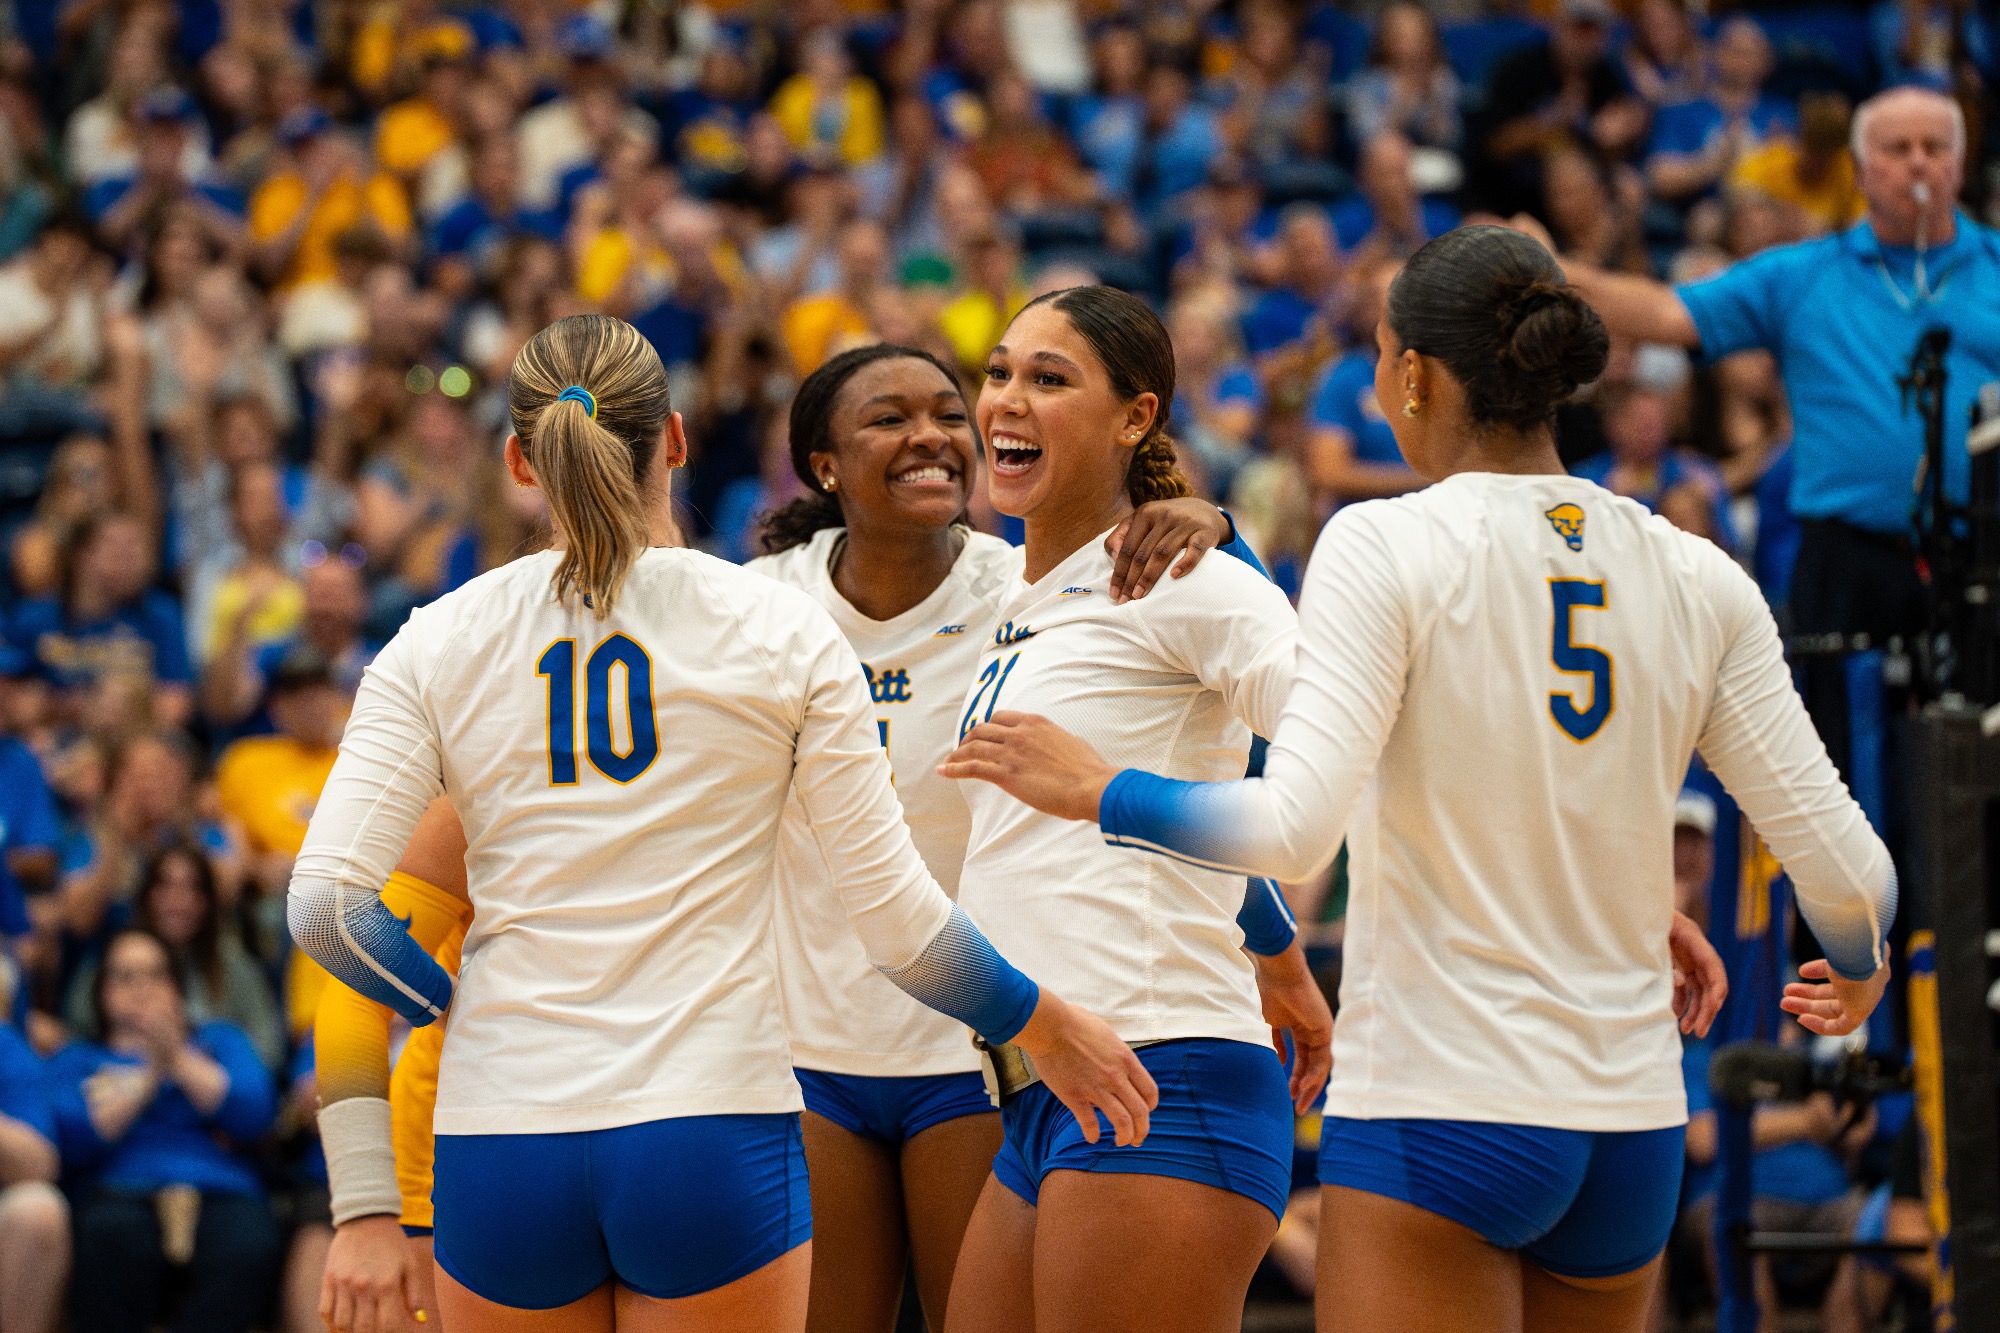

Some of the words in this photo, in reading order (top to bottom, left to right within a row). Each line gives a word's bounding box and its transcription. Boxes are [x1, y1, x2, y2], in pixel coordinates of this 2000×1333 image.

[935, 624, 968, 636] ACC
[1061, 586, 1093, 595] ACC
[959, 650, 1023, 743] 21
[1547, 577, 1616, 745] 5
[535, 630, 662, 787] 10
